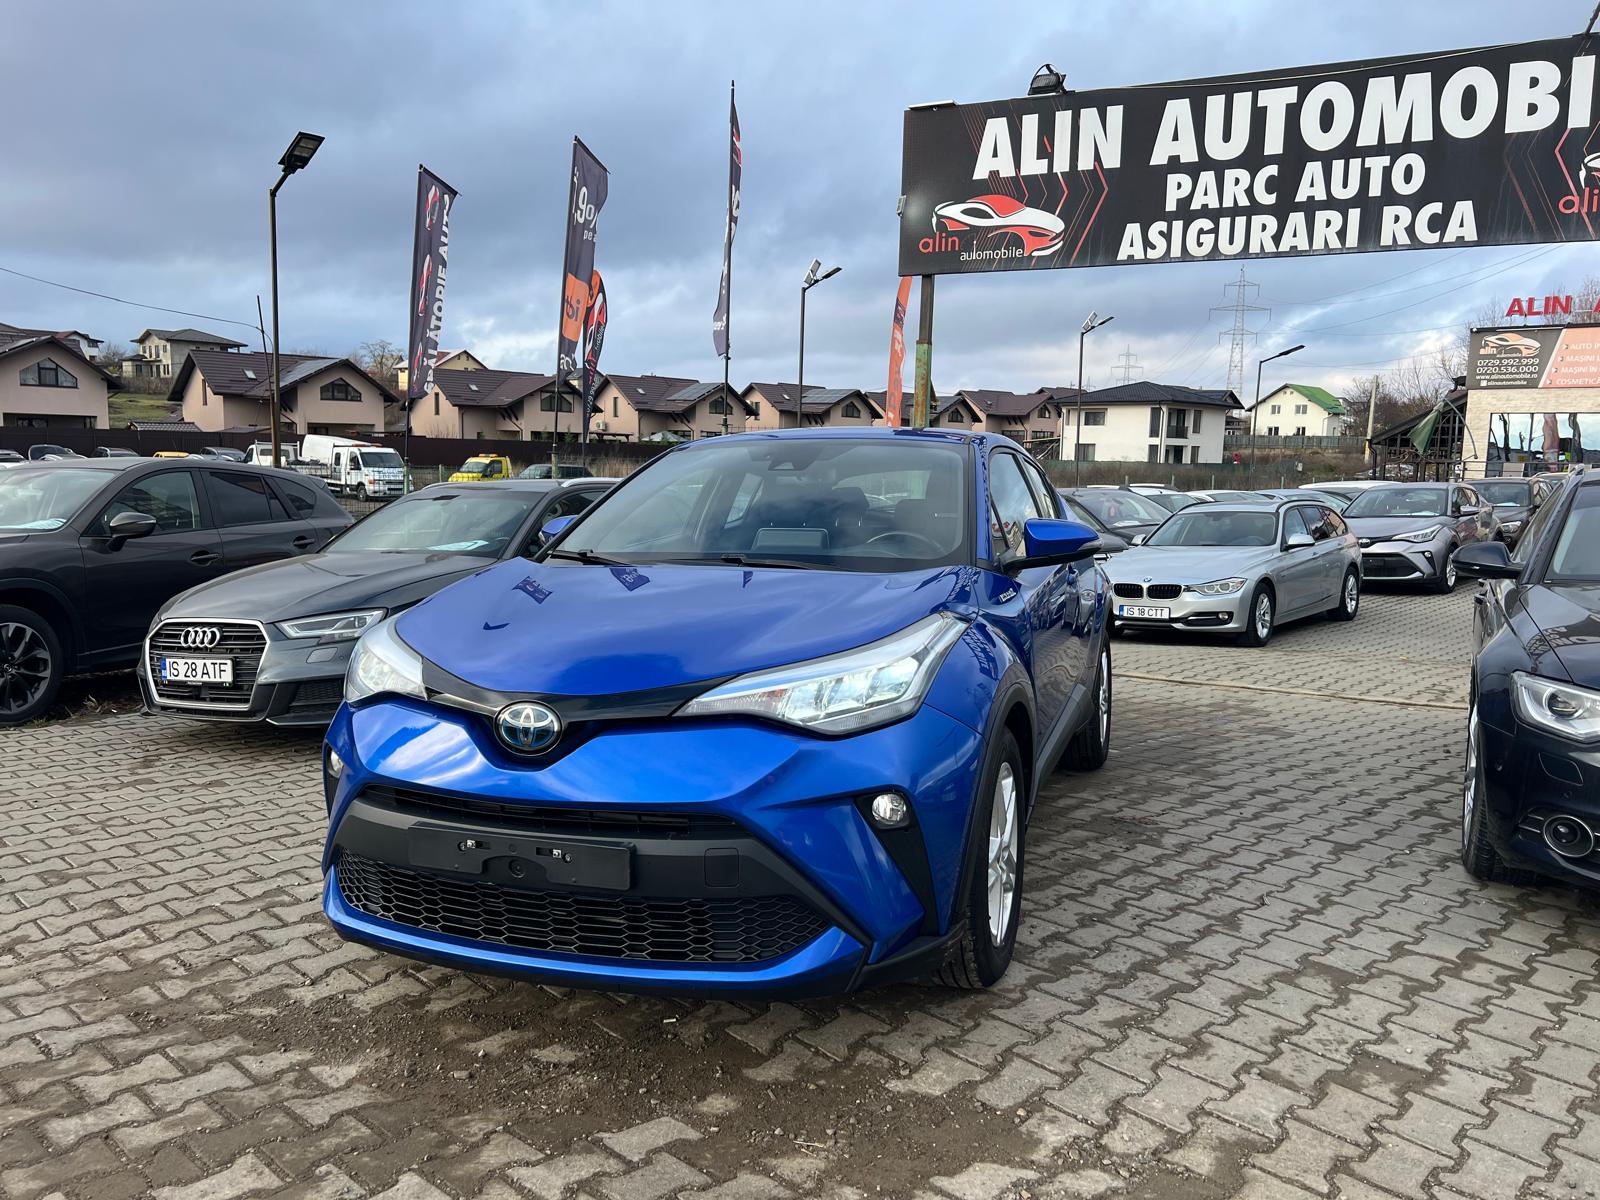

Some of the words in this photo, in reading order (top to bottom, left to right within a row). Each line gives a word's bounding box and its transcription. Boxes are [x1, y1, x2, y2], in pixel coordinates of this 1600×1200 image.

[972, 104, 1123, 180] ALIN
[1149, 54, 1596, 166] AUTOMOBI
[1165, 164, 1278, 212] PARC
[1294, 152, 1426, 202] AUTO
[1117, 207, 1360, 261] ASIGURARI
[1380, 200, 1478, 247] RCA
[919, 231, 959, 254] alin
[960, 240, 1023, 261] automobile
[1505, 295, 1572, 317] ALIN
[1476, 365, 1539, 374] 0720.536.000
[1477, 357, 1540, 367] 0729.992.999
[1126, 607, 1134, 615] IS
[1137, 607, 1145, 616] 18
[1147, 608, 1164, 617] CTT
[169, 661, 179, 676] IS
[183, 662, 197, 678] 28
[201, 662, 227, 679] ATF
